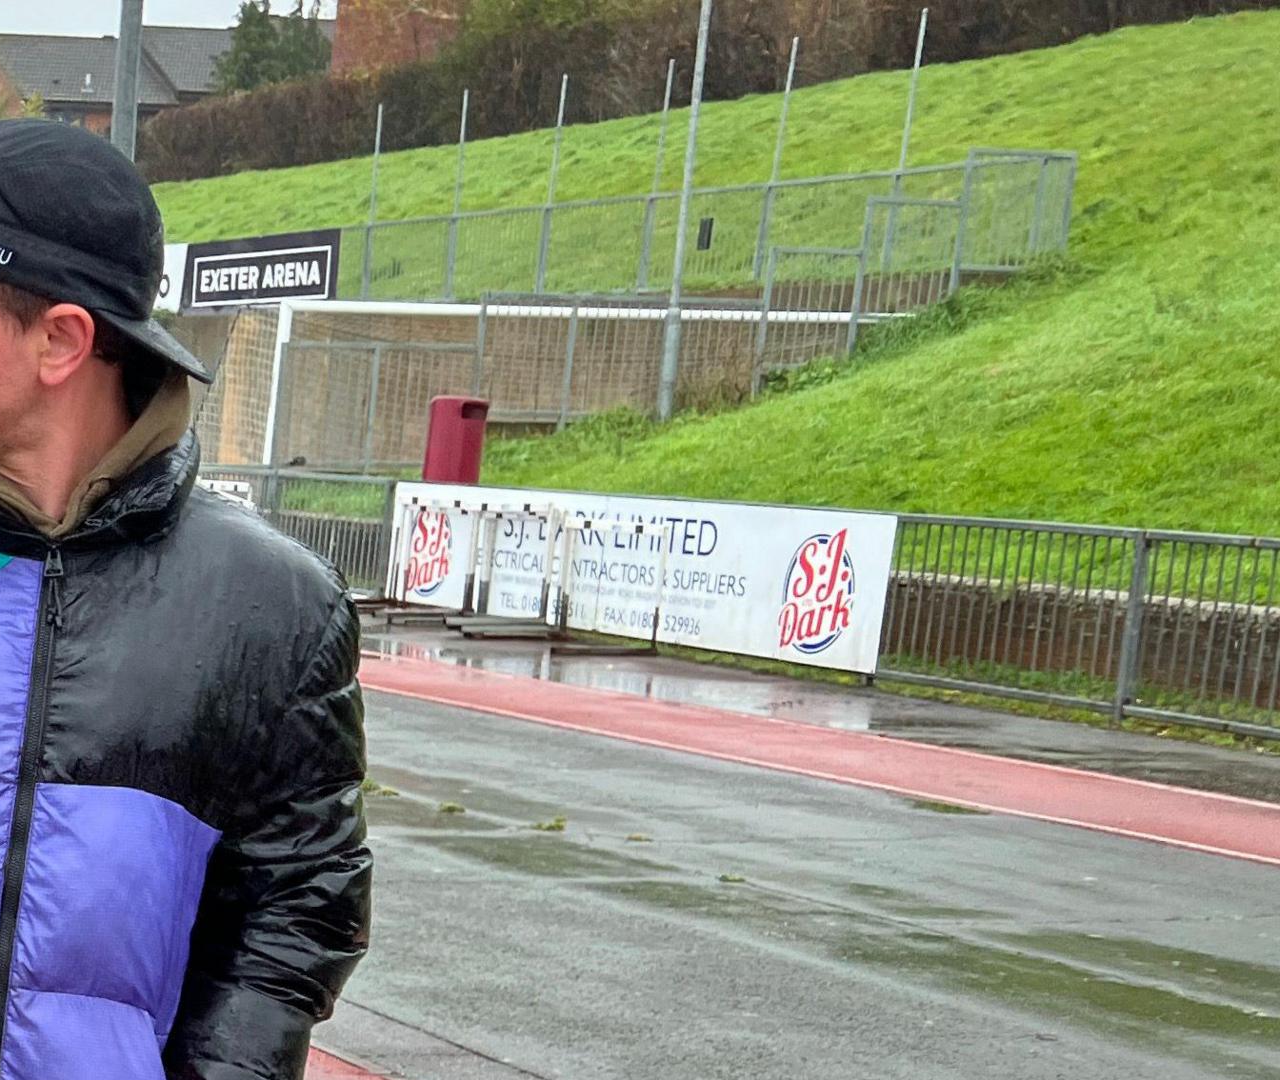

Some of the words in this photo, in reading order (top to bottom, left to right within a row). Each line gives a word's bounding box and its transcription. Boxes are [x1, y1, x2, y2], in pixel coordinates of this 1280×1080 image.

[200, 265, 259, 293] EXETER
[261, 260, 321, 289] ARENA
[673, 569, 747, 597] SUPPLIERS
[664, 614, 701, 635] 529936
[777, 589, 852, 648] Dark
